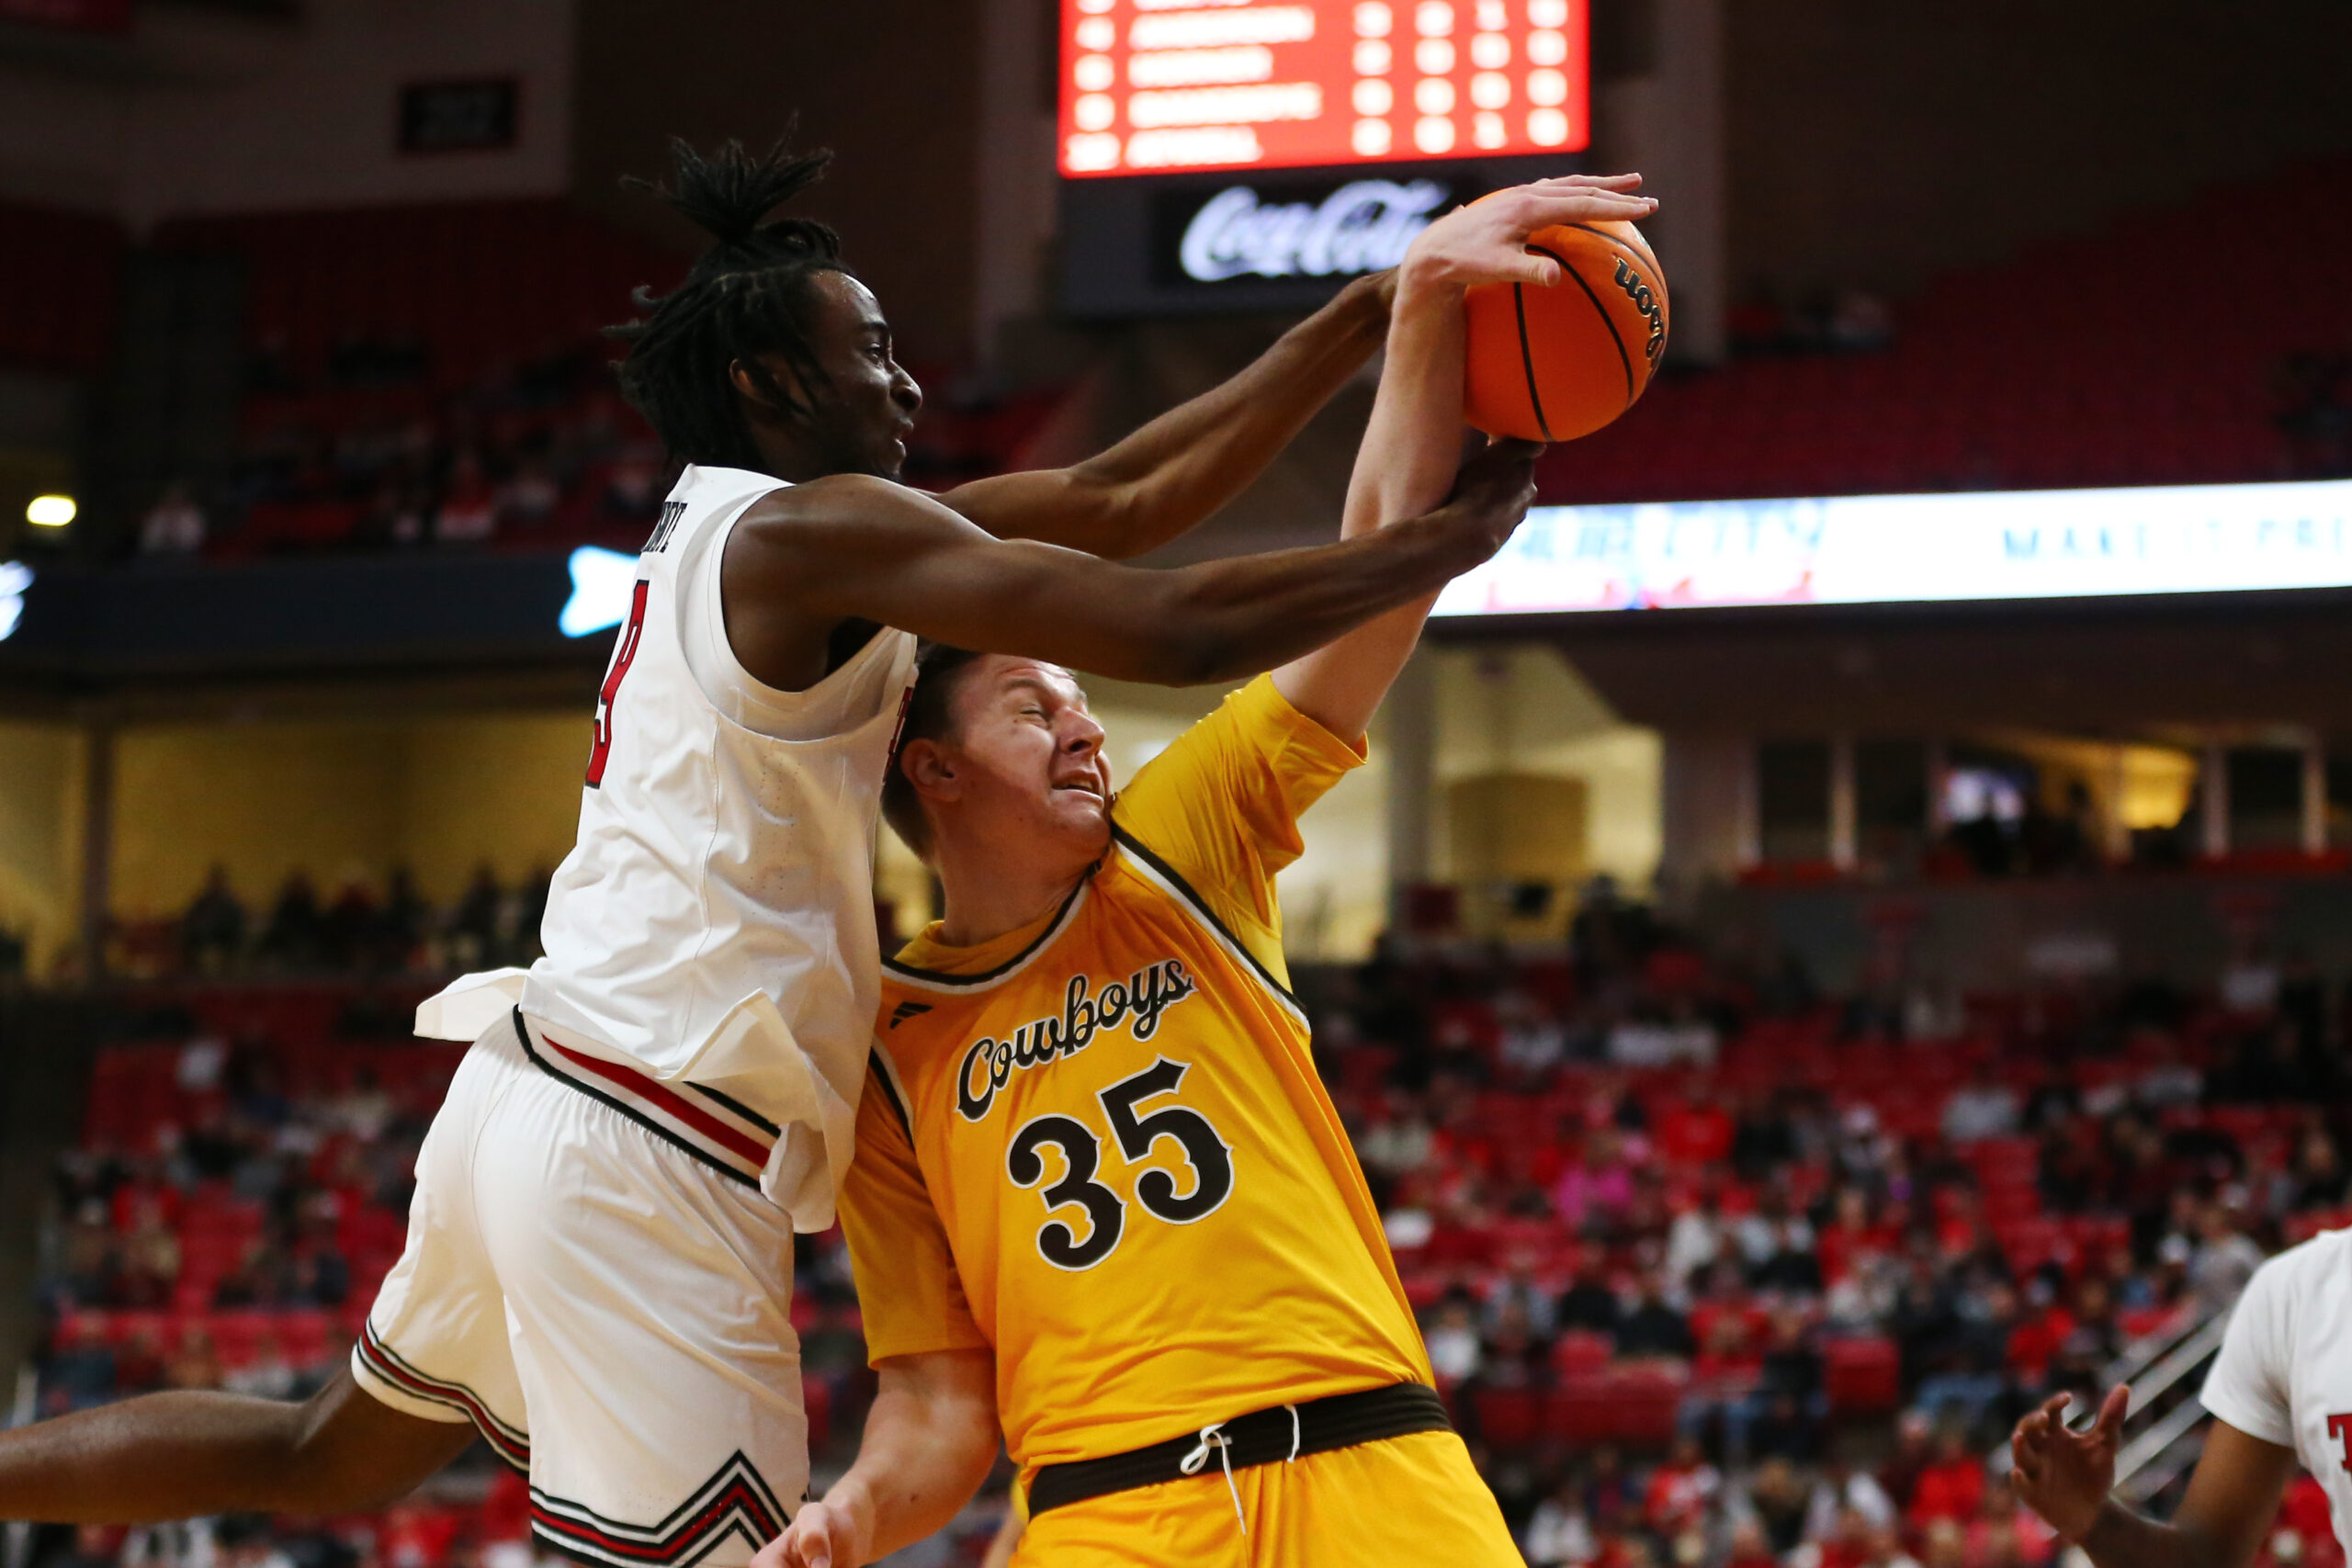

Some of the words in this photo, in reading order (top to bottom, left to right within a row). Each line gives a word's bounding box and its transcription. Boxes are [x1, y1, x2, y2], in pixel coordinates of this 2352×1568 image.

[1612, 254, 1665, 369] lson
[954, 958, 1199, 1123] Cowboys
[1005, 1053, 1236, 1273] 35
